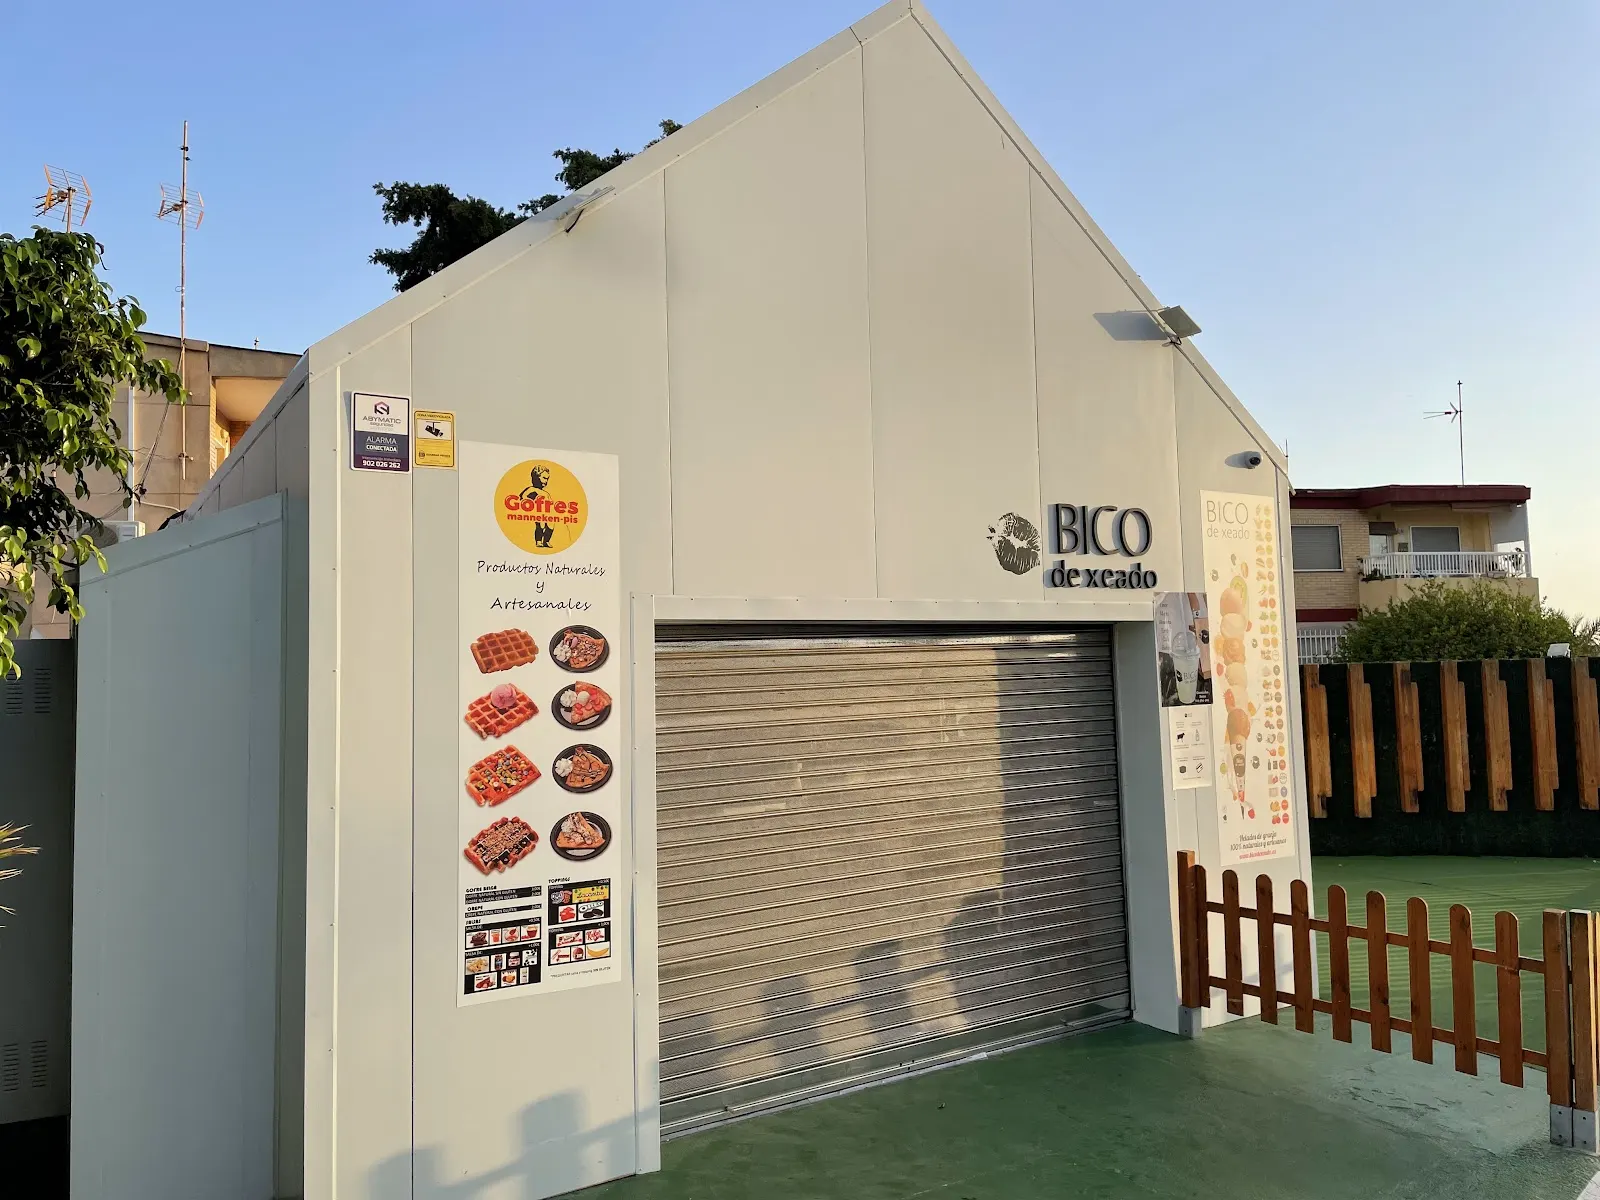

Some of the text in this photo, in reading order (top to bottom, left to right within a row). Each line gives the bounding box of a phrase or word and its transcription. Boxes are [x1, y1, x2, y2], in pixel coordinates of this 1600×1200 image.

[362, 415, 401, 424] ABYMATIC
[366, 435, 397, 445] ALARMA
[365, 444, 397, 453] CONECTADA
[362, 459, 375, 467] 902
[504, 494, 579, 515] Gofres
[506, 513, 579, 525] manneken-pis
[1205, 500, 1249, 525] BICO
[1051, 502, 1153, 557] BICO
[1206, 523, 1251, 540] de xeado
[476, 560, 606, 577] Productos Naturales
[1049, 559, 1158, 590] de xeado
[535, 580, 545, 594] y
[489, 597, 592, 612] Artesanales
